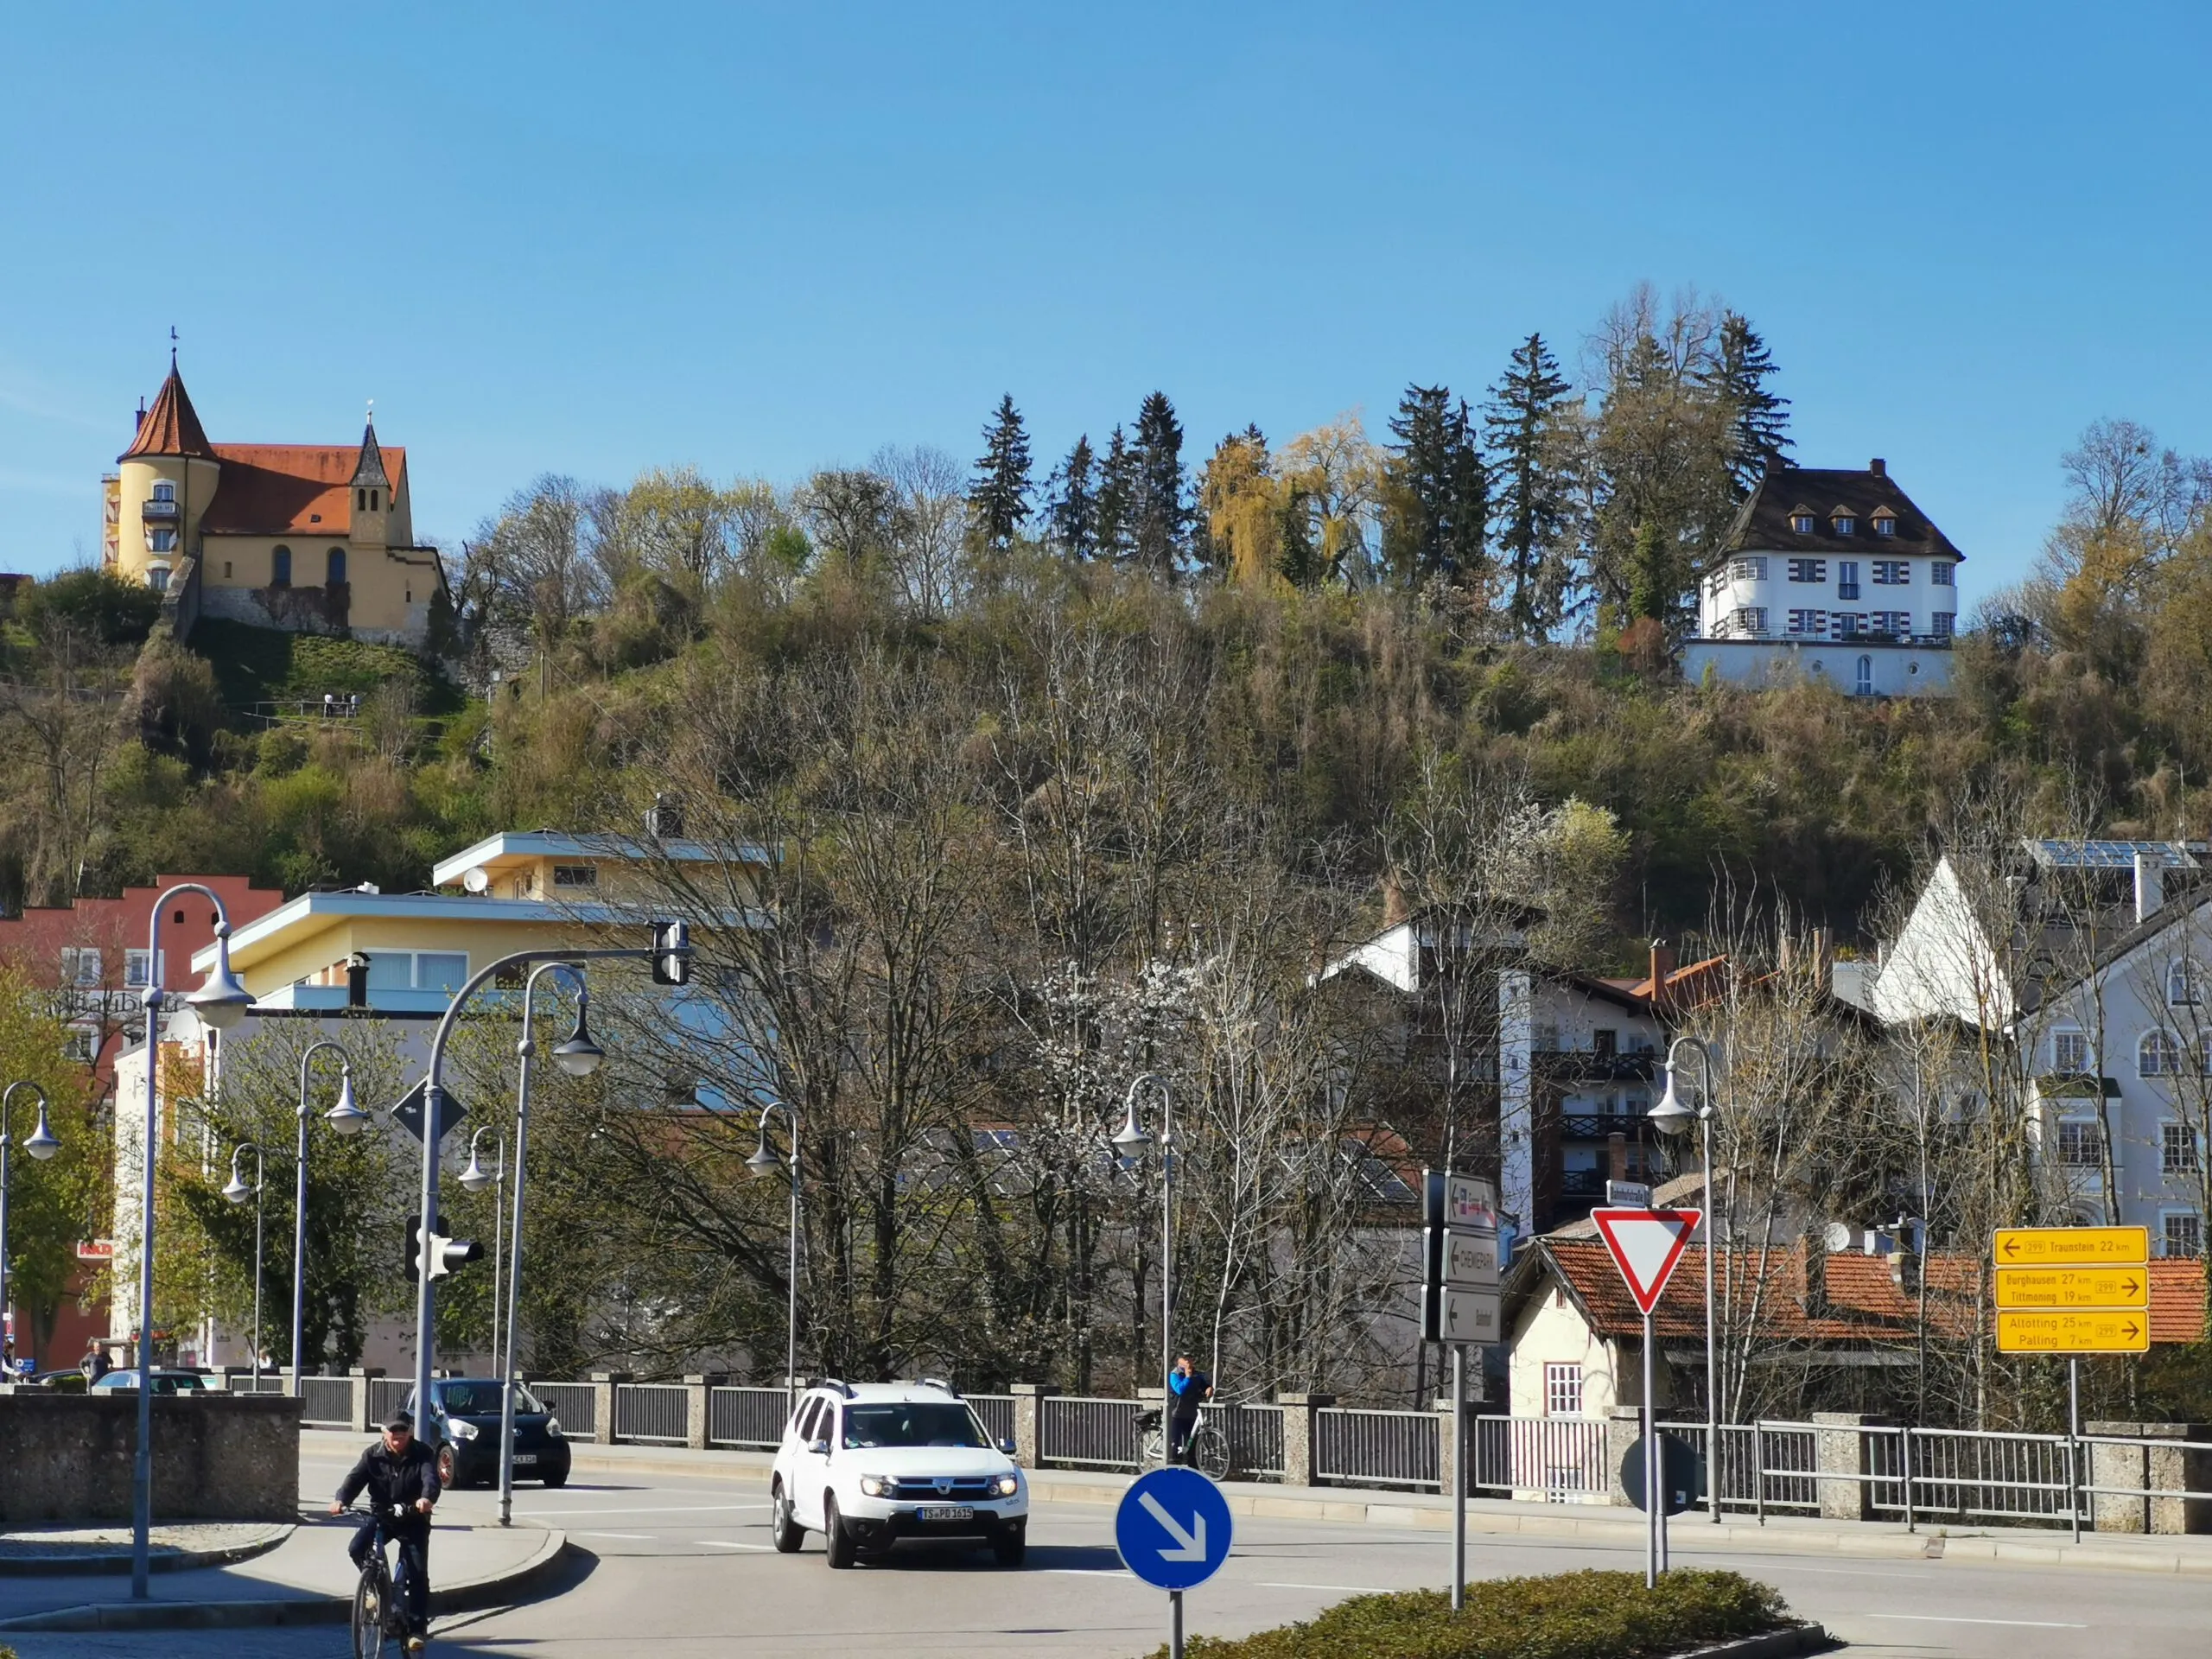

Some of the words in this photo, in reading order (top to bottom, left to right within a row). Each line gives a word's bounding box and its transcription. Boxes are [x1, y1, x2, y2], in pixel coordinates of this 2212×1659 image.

[2027, 1243, 2044, 1251] 299
[2050, 1242, 2094, 1252] Traunstein
[2101, 1241, 2113, 1251] 22
[2006, 1274, 2056, 1287] Burghausen
[2062, 1274, 2075, 1284] 27
[2098, 1283, 2114, 1292] 299
[2012, 1292, 2056, 1304] Tittmoning
[2064, 1291, 2075, 1301] 19
[2010, 1318, 2057, 1331] Altötting
[2063, 1318, 2075, 1328] 25
[2098, 1327, 2114, 1336] 299
[2019, 1335, 2057, 1348] Palling
[2069, 1335, 2075, 1344] 7
